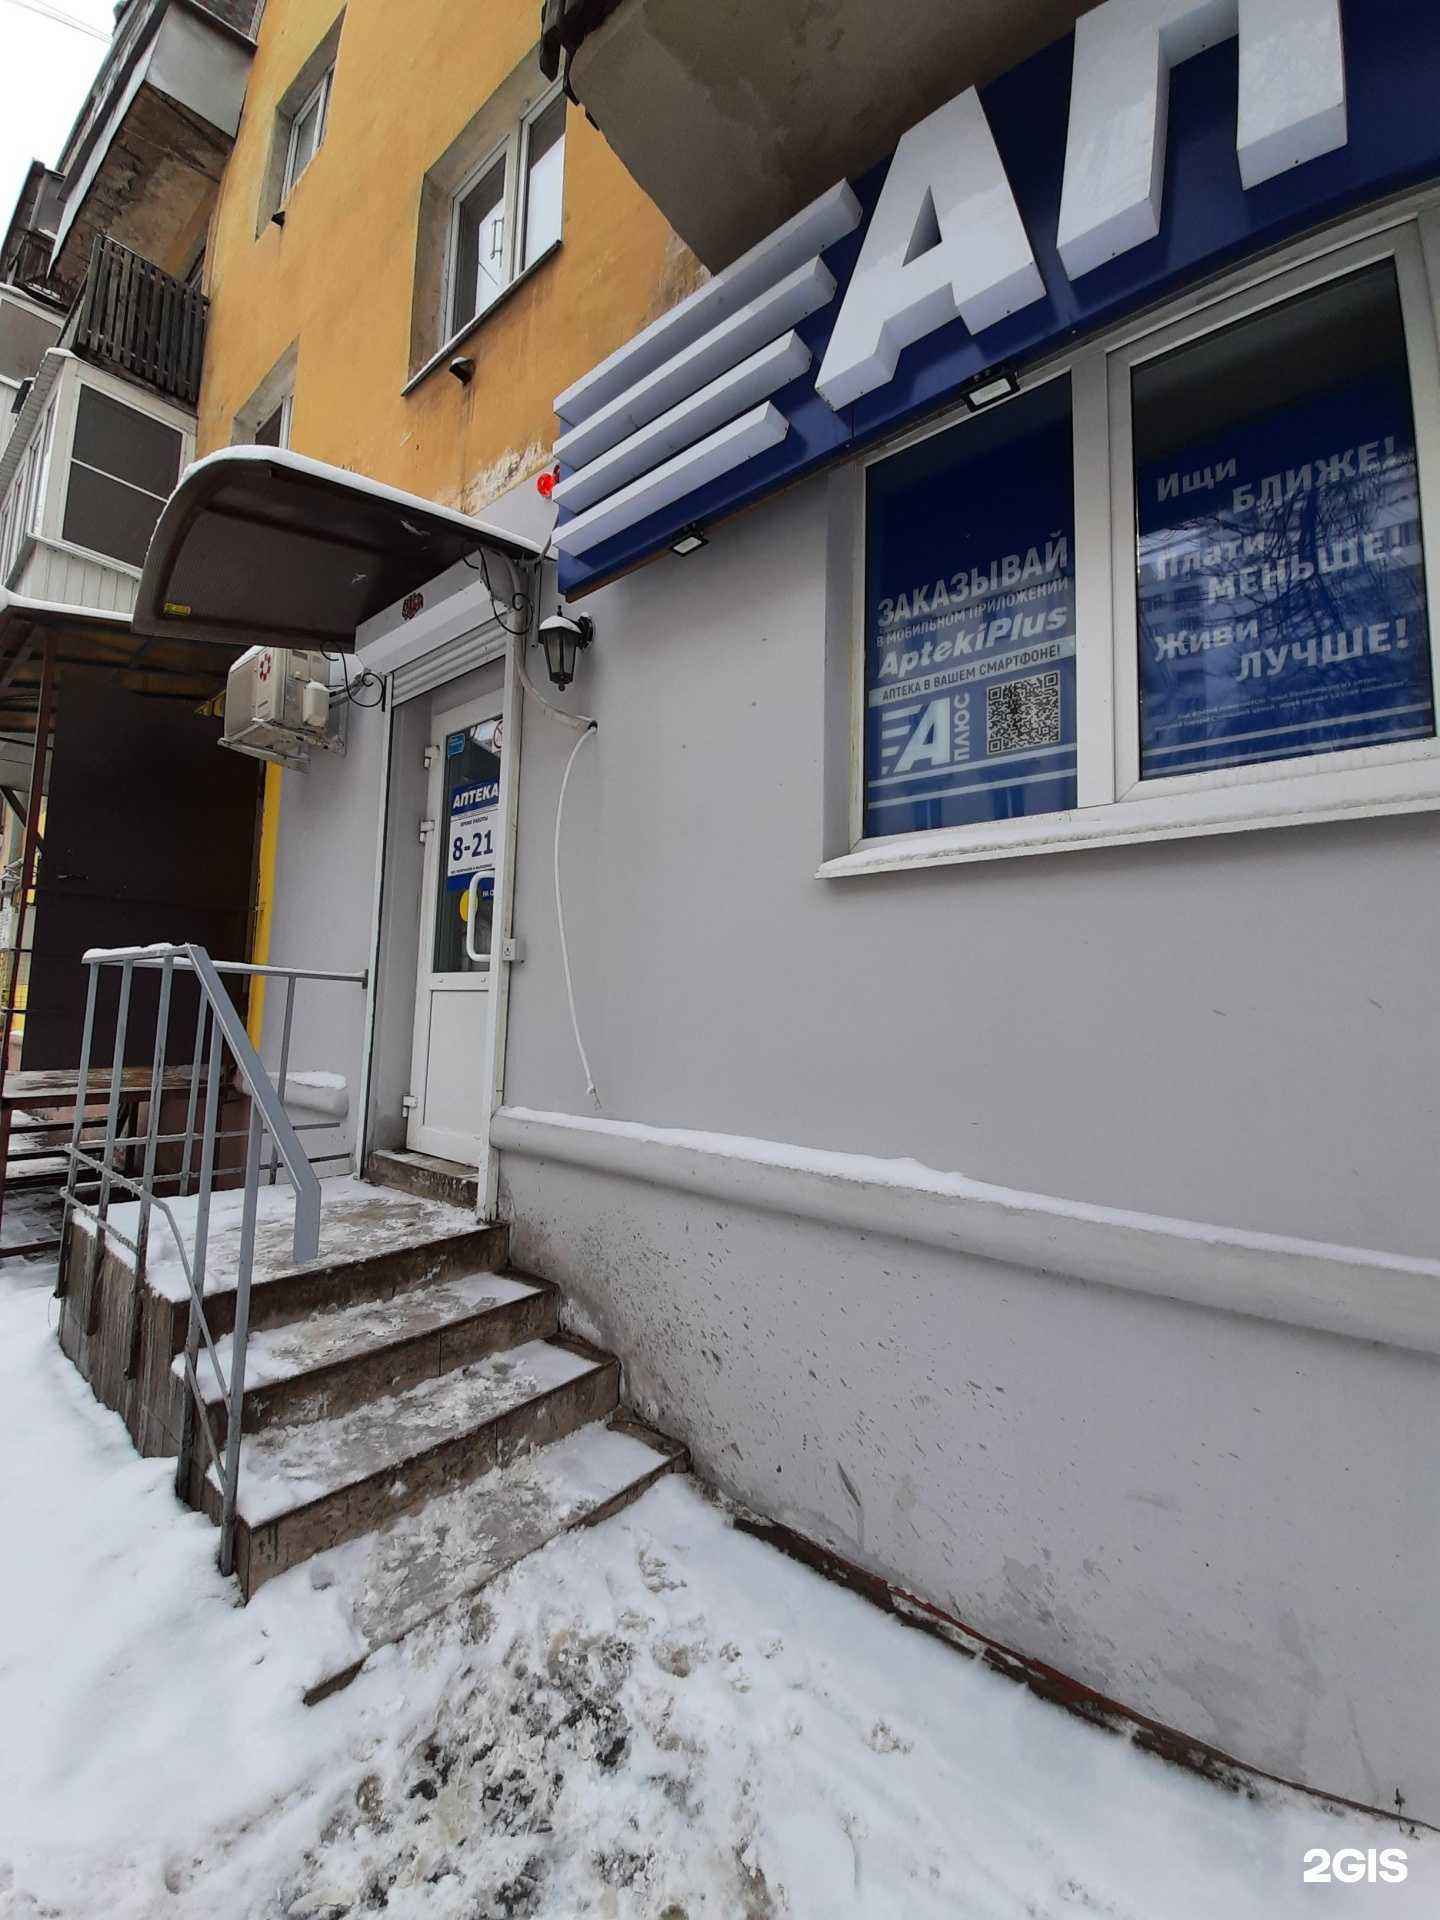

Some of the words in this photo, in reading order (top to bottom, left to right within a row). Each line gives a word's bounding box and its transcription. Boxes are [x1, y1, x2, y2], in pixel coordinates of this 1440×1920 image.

[1157, 458, 1237, 502] Ищи
[1233, 436, 1395, 513] БЛИЖЕ!
[878, 530, 1068, 627] ЗАКАЗЫВАЙ
[1156, 532, 1265, 581] Плати
[886, 609, 966, 644] МОБИЛЬНОМ
[966, 577, 1069, 617] ПРИЛОЖЕНИИ
[1154, 618, 1258, 662] Живи
[878, 606, 1067, 678] AptekiPlus
[1236, 618, 1408, 682] ЛУЧШЕ!
[883, 679, 921, 701] АПТЕКА
[924, 679, 929, 690] В
[934, 667, 976, 688] ВАШЕМ
[979, 644, 1061, 676] СМАРТФОНЕ!
[954, 690, 970, 761] ПЛЮС
[453, 783, 499, 808] АПТЕКА
[453, 829, 493, 861] 8-21
